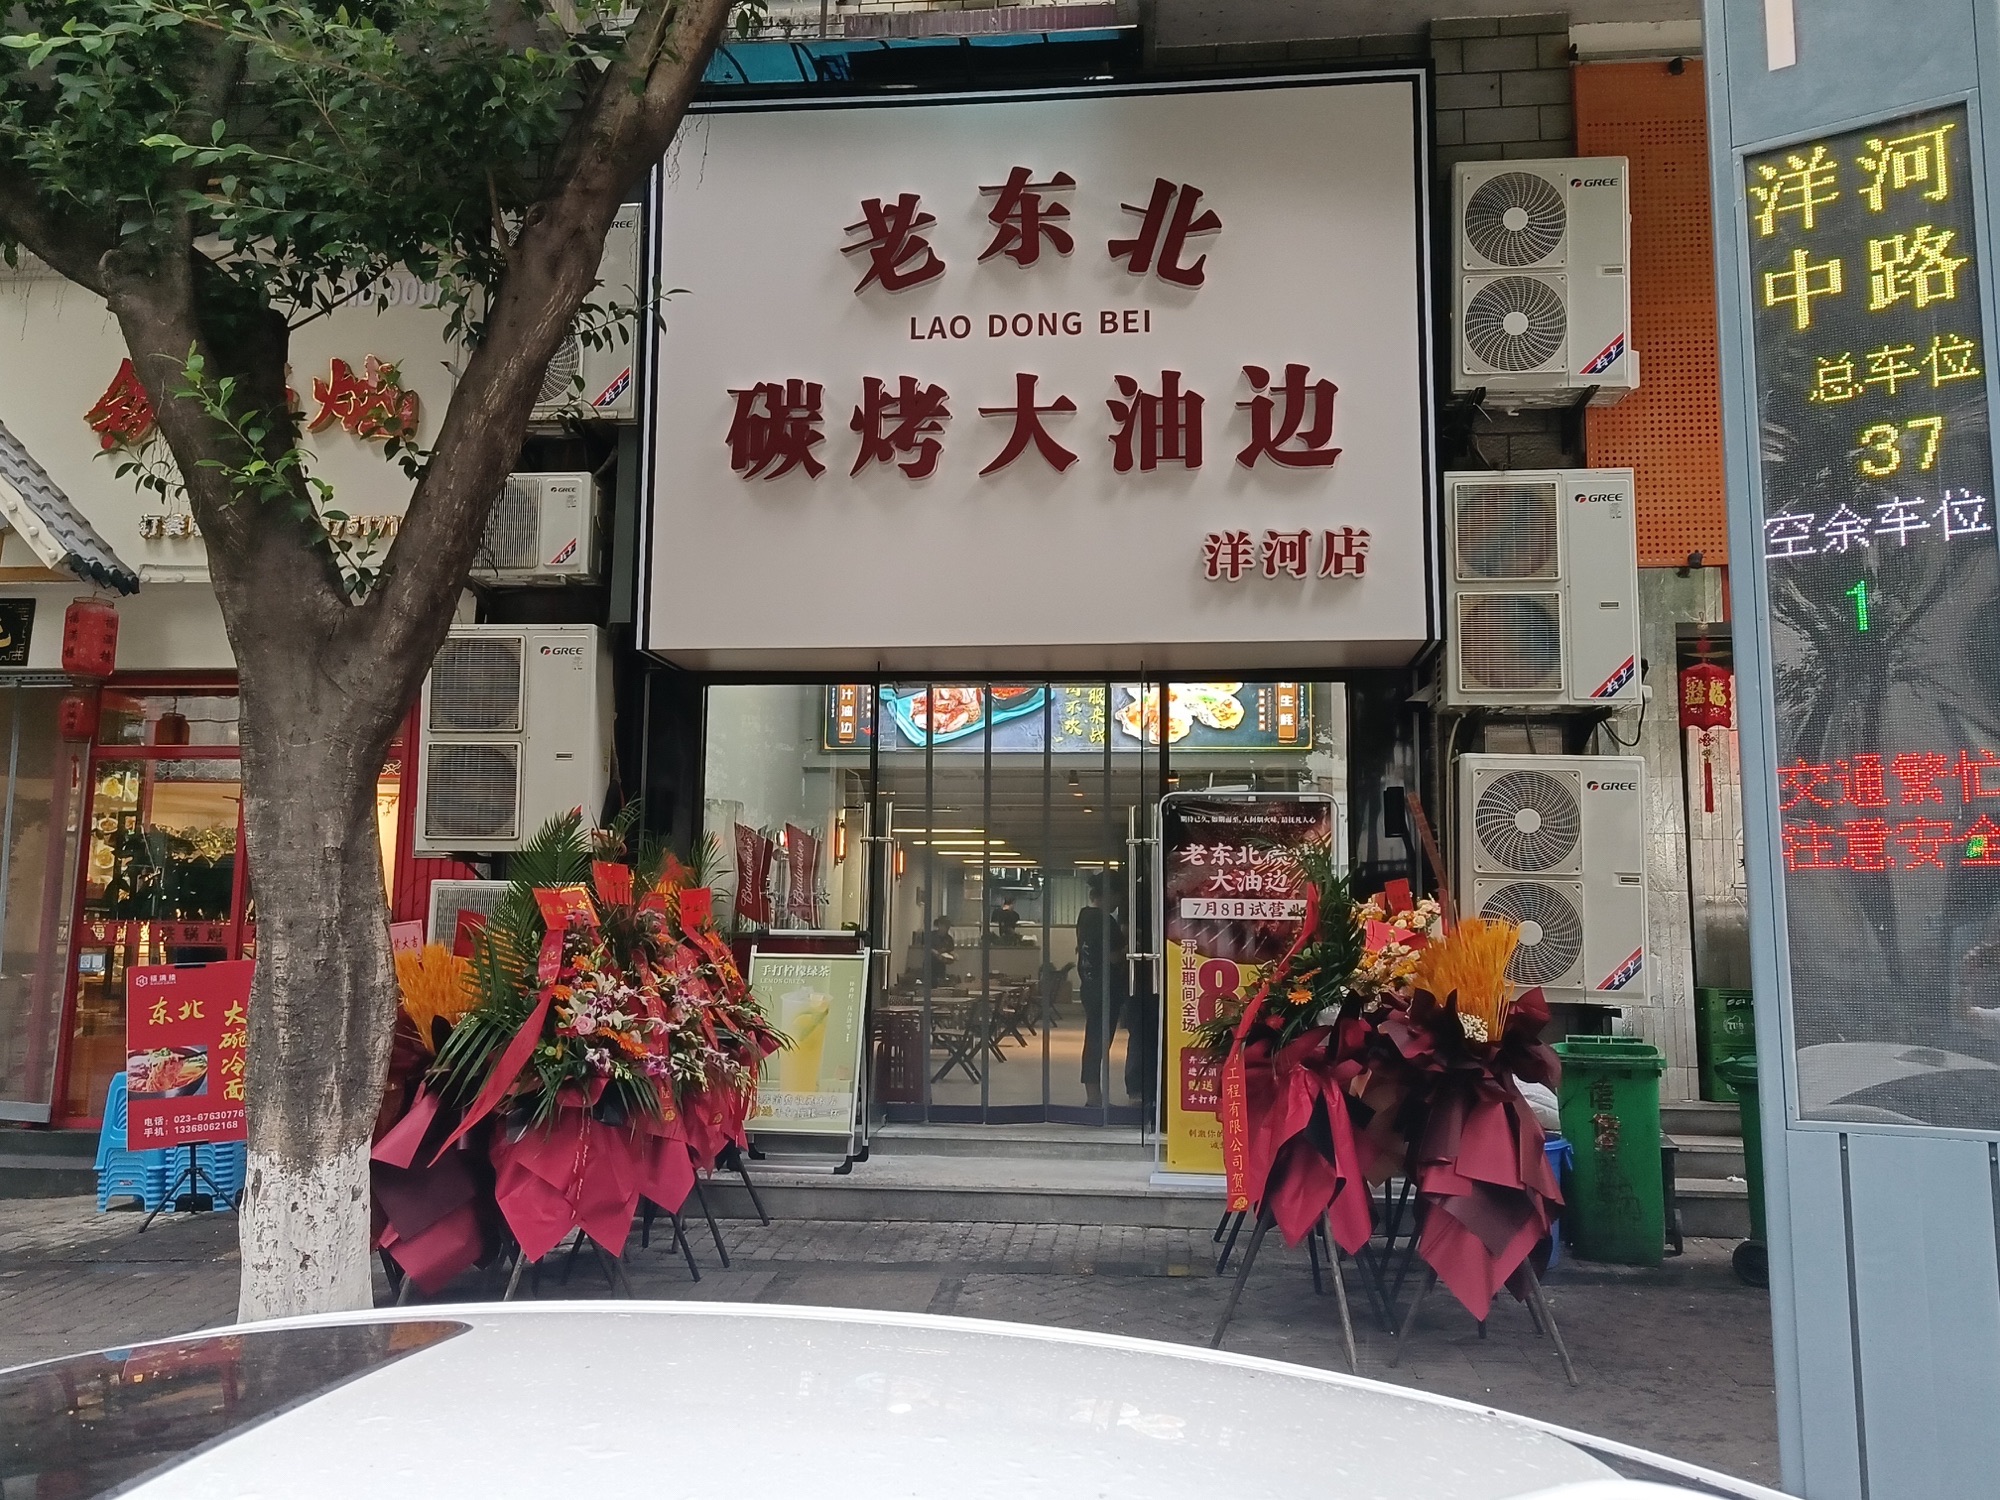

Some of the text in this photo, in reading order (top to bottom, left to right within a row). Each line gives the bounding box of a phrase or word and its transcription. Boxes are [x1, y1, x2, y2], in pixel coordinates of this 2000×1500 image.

[1584, 178, 1618, 187] GREE
[1751, 124, 1955, 235] 洋河
[840, 166, 1223, 296] 老东北
[1765, 225, 1968, 329] 中路
[910, 310, 1152, 340] LAO DONG BEI
[1809, 334, 1980, 401] 总车位
[724, 363, 1341, 480] 碳烤大油边
[1861, 416, 1943, 476] 37
[1588, 493, 1623, 502] GREE
[1763, 488, 1991, 559] 空余车位
[1203, 527, 1371, 581] 洋河店
[1846, 580, 1869, 632] 1
[552, 646, 583, 655] GREE
[1601, 782, 1636, 791] GREE
[1776, 749, 2000, 810] 交通繁忙
[1180, 842, 1313, 866] 老东北碳
[1781, 814, 2000, 871] 注意安全
[741, 838, 753, 906] Budweiser
[793, 839, 804, 907] Budweiser
[1208, 868, 1290, 893] 大油边
[760, 964, 830, 978] 手打柠檬绿茶
[1181, 940, 1197, 1033] 开业期间全场
[148, 997, 205, 1025] 东北
[218, 1000, 247, 1101] 大碗冷面
[174, 1109, 244, 1123] 023-67630776
[174, 1120, 238, 1134] 13368062168
